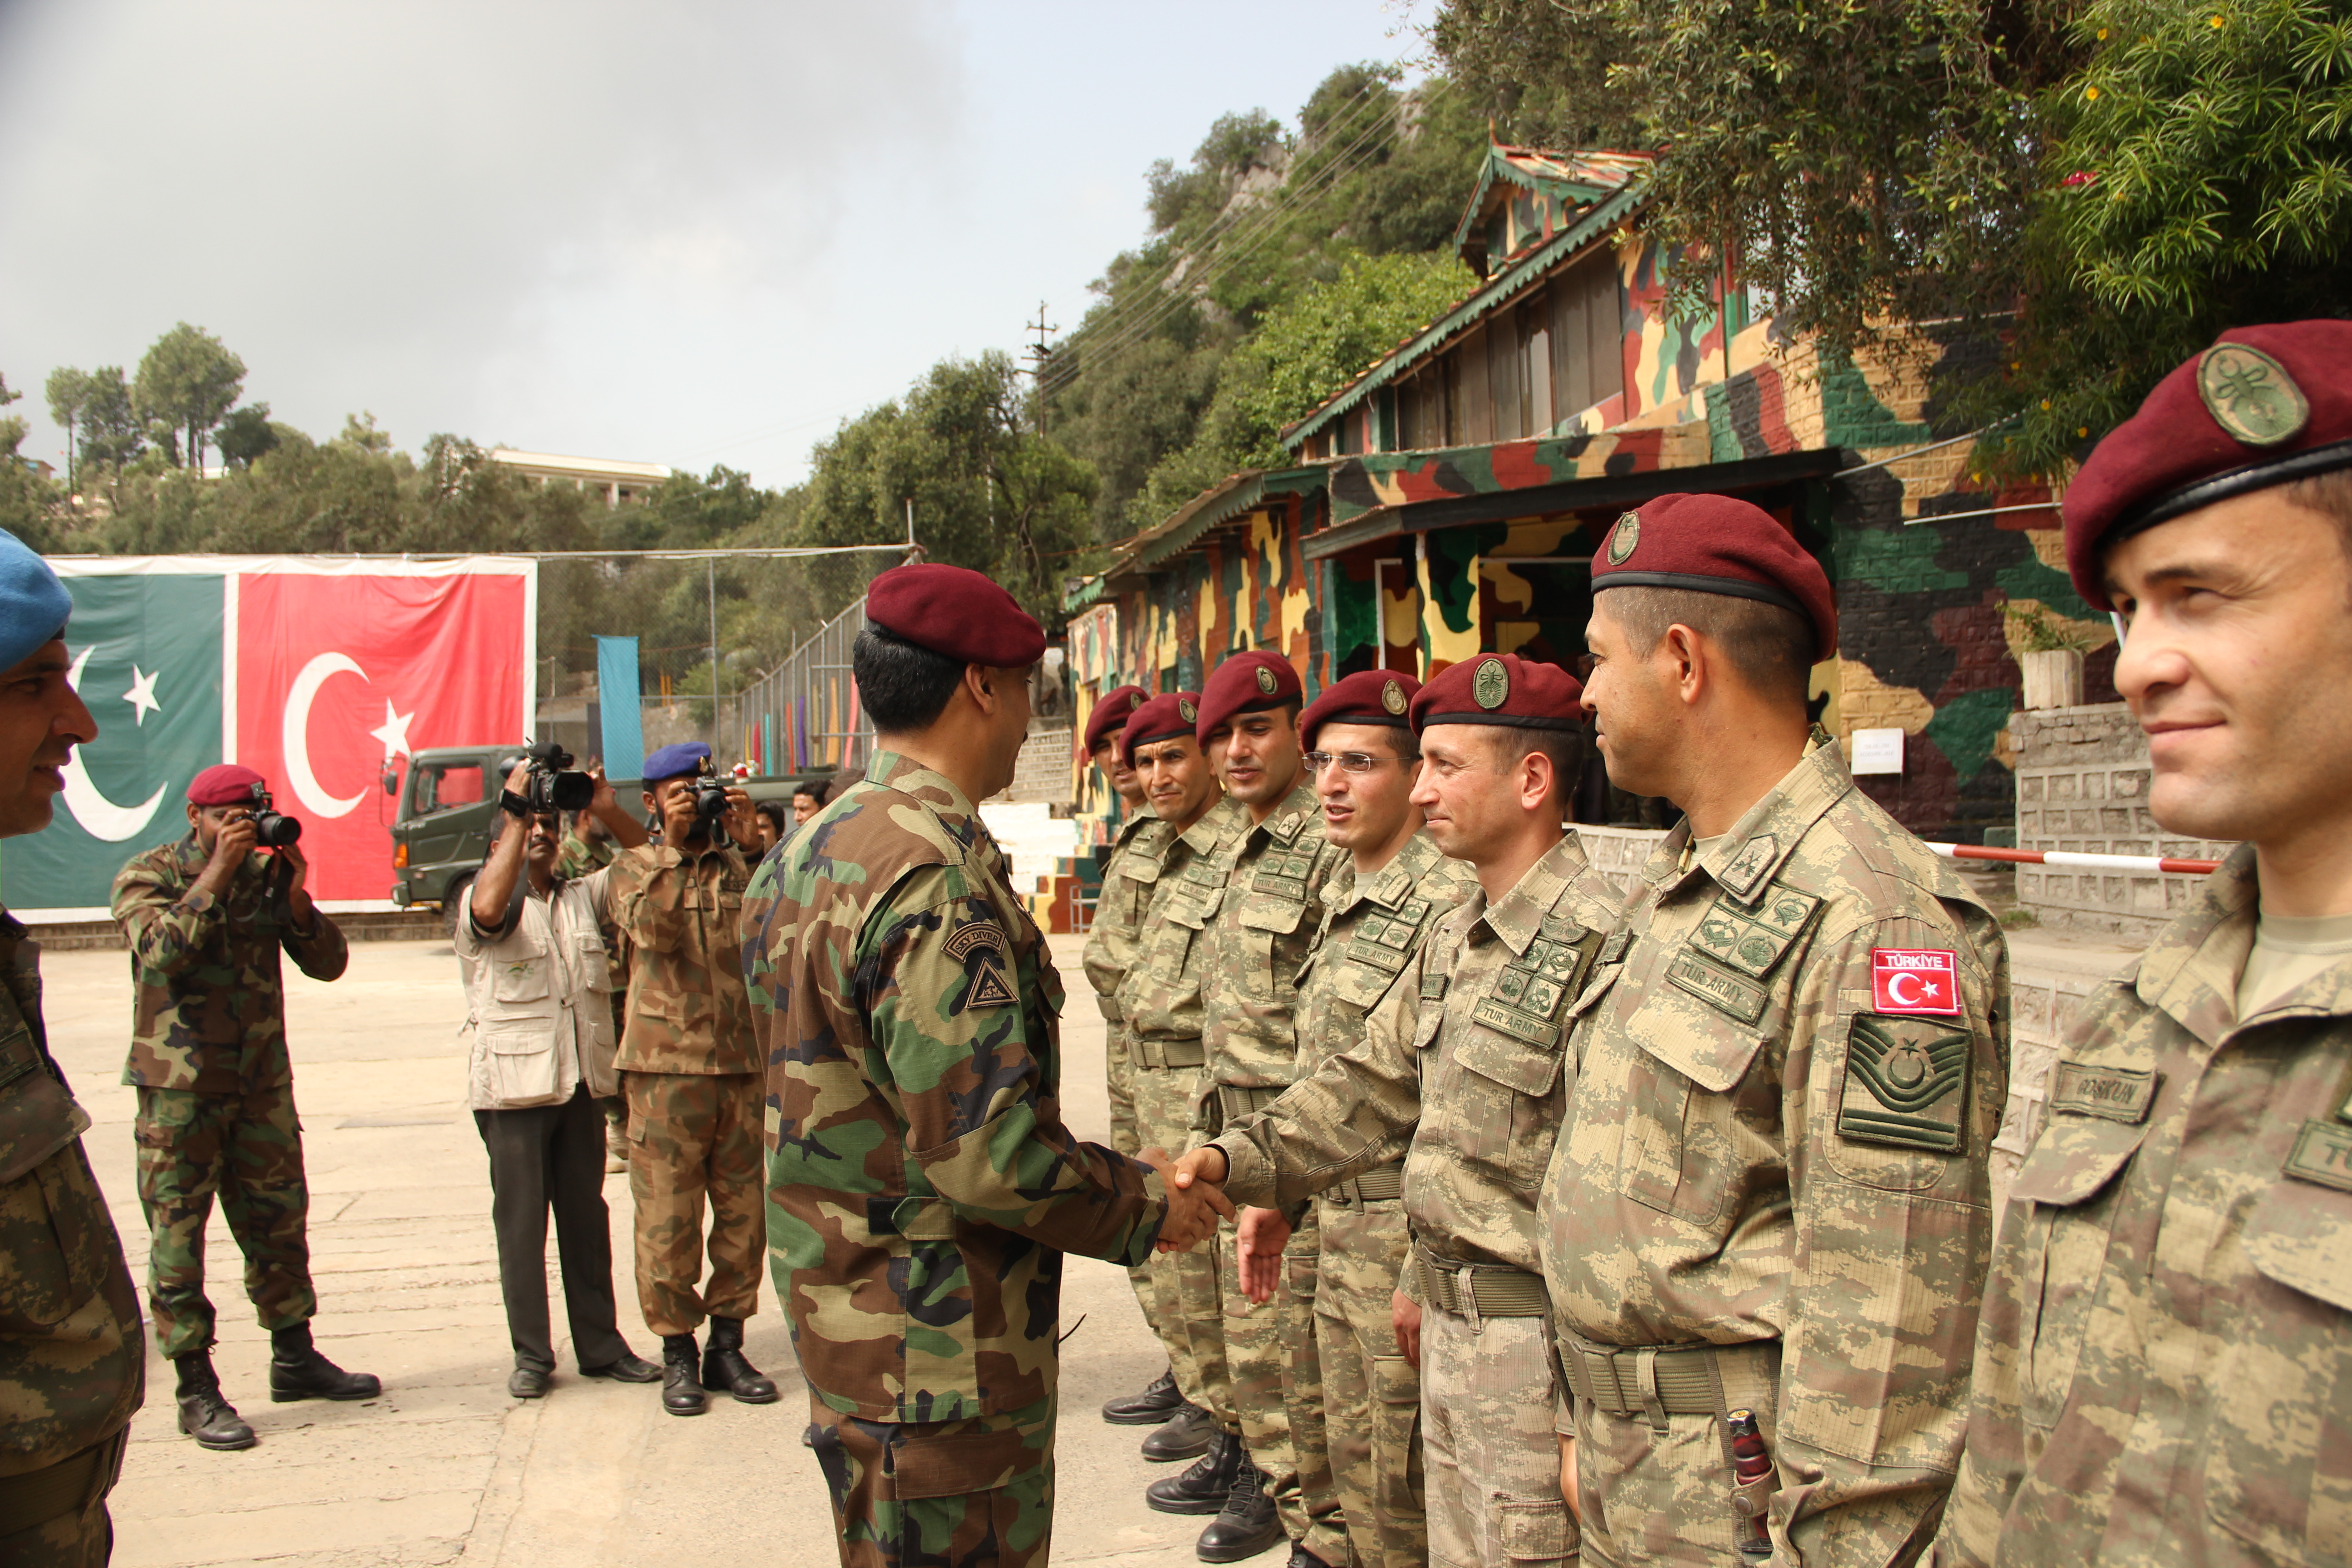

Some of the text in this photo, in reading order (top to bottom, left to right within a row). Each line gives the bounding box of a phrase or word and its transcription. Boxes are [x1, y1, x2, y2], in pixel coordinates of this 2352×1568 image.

[1258, 879, 1297, 892] TUR ARMY
[955, 931, 999, 952] SKY DIVER
[1355, 946, 1395, 964] TUR ARMY
[1885, 953, 1943, 967] TÜRKİYE
[1681, 962, 1746, 1003] TUR ARMY
[1484, 1007, 1543, 1038] TUR ARMY
